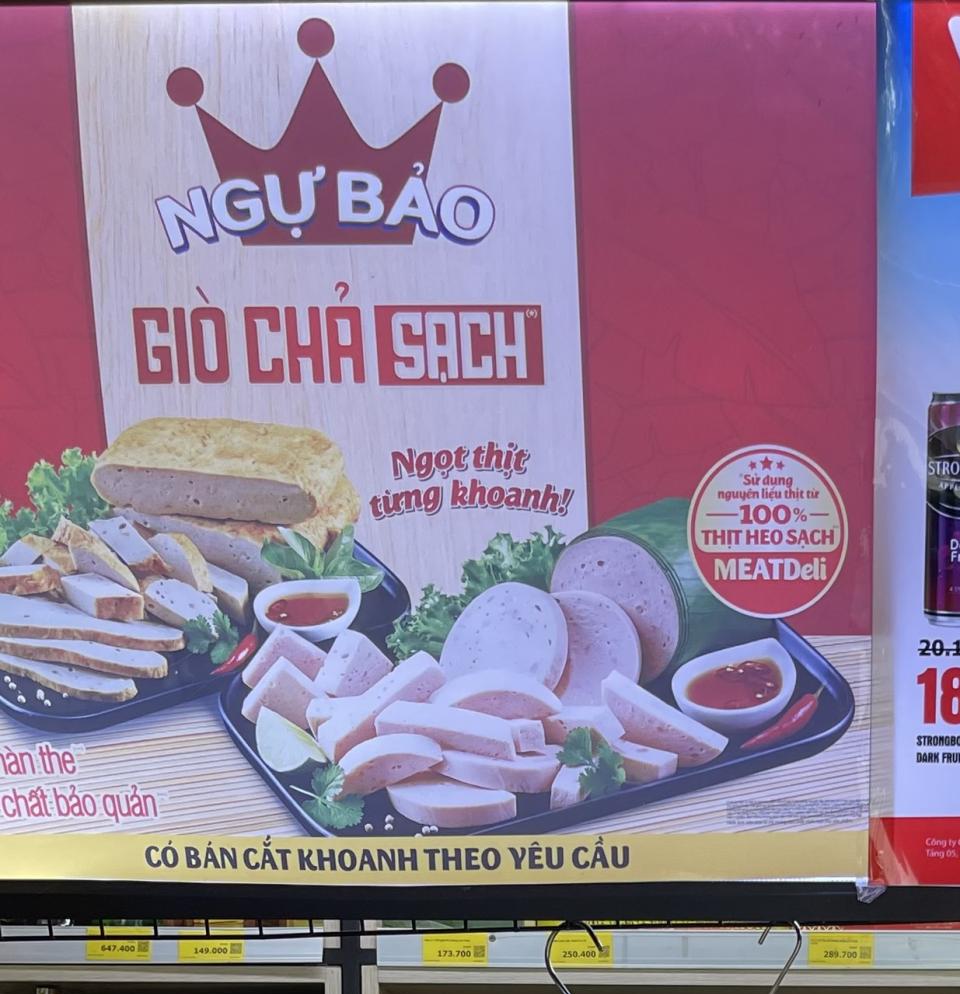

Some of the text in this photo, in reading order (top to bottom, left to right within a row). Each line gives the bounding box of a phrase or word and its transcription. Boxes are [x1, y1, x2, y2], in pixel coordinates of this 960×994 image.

[155, 162, 496, 253] NGỰ BẢO
[132, 281, 527, 385] GIÒ CHẢ SẠCH
[392, 442, 529, 481] Ngọt thịt
[368, 478, 574, 520] từng khoanh!
[739, 503, 808, 526] 100%
[702, 528, 836, 550] THỊT HEO SẠCH
[713, 556, 828, 582] MEATDeli
[916, 752, 939, 764] DARK
[2, 785, 159, 825] chất bảo quản
[145, 835, 631, 872] CÓ BÁN CẮT KHOANH THEO YÊU CẦU
[100, 945, 136, 953] 647.400
[193, 946, 229, 955] 149.000
[437, 950, 472, 958] 173.700
[562, 950, 597, 959] 250.400
[823, 950, 858, 959] 289.700
